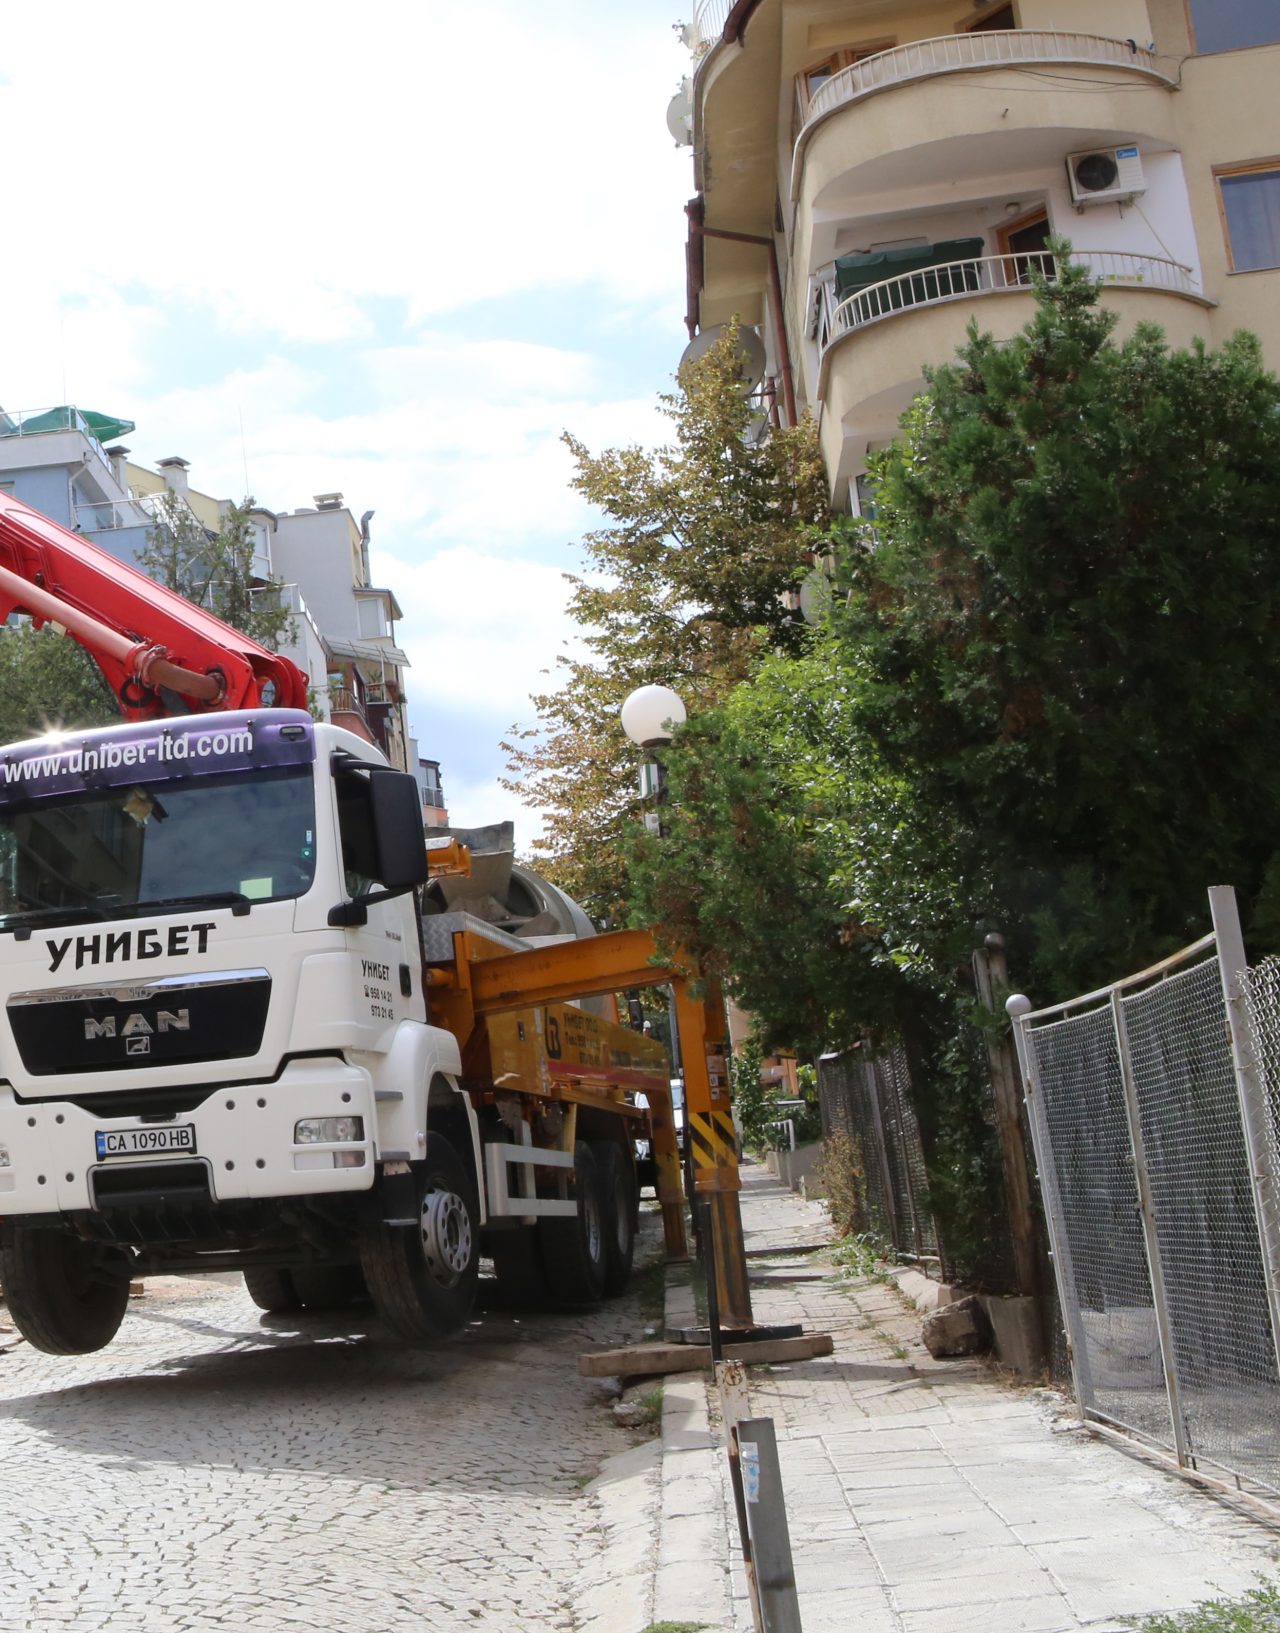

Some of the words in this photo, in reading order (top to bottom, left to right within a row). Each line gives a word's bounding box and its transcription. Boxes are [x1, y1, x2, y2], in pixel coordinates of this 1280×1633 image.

[4, 731, 254, 783] www.unibet-ltd.com
[46, 922, 217, 973] УНИБЕТ
[361, 959, 390, 981] УНИБЕТ
[84, 1008, 191, 1040] MAN
[107, 1134, 127, 1151] CA
[131, 1131, 167, 1150] 1090
[169, 1130, 190, 1147] HB
